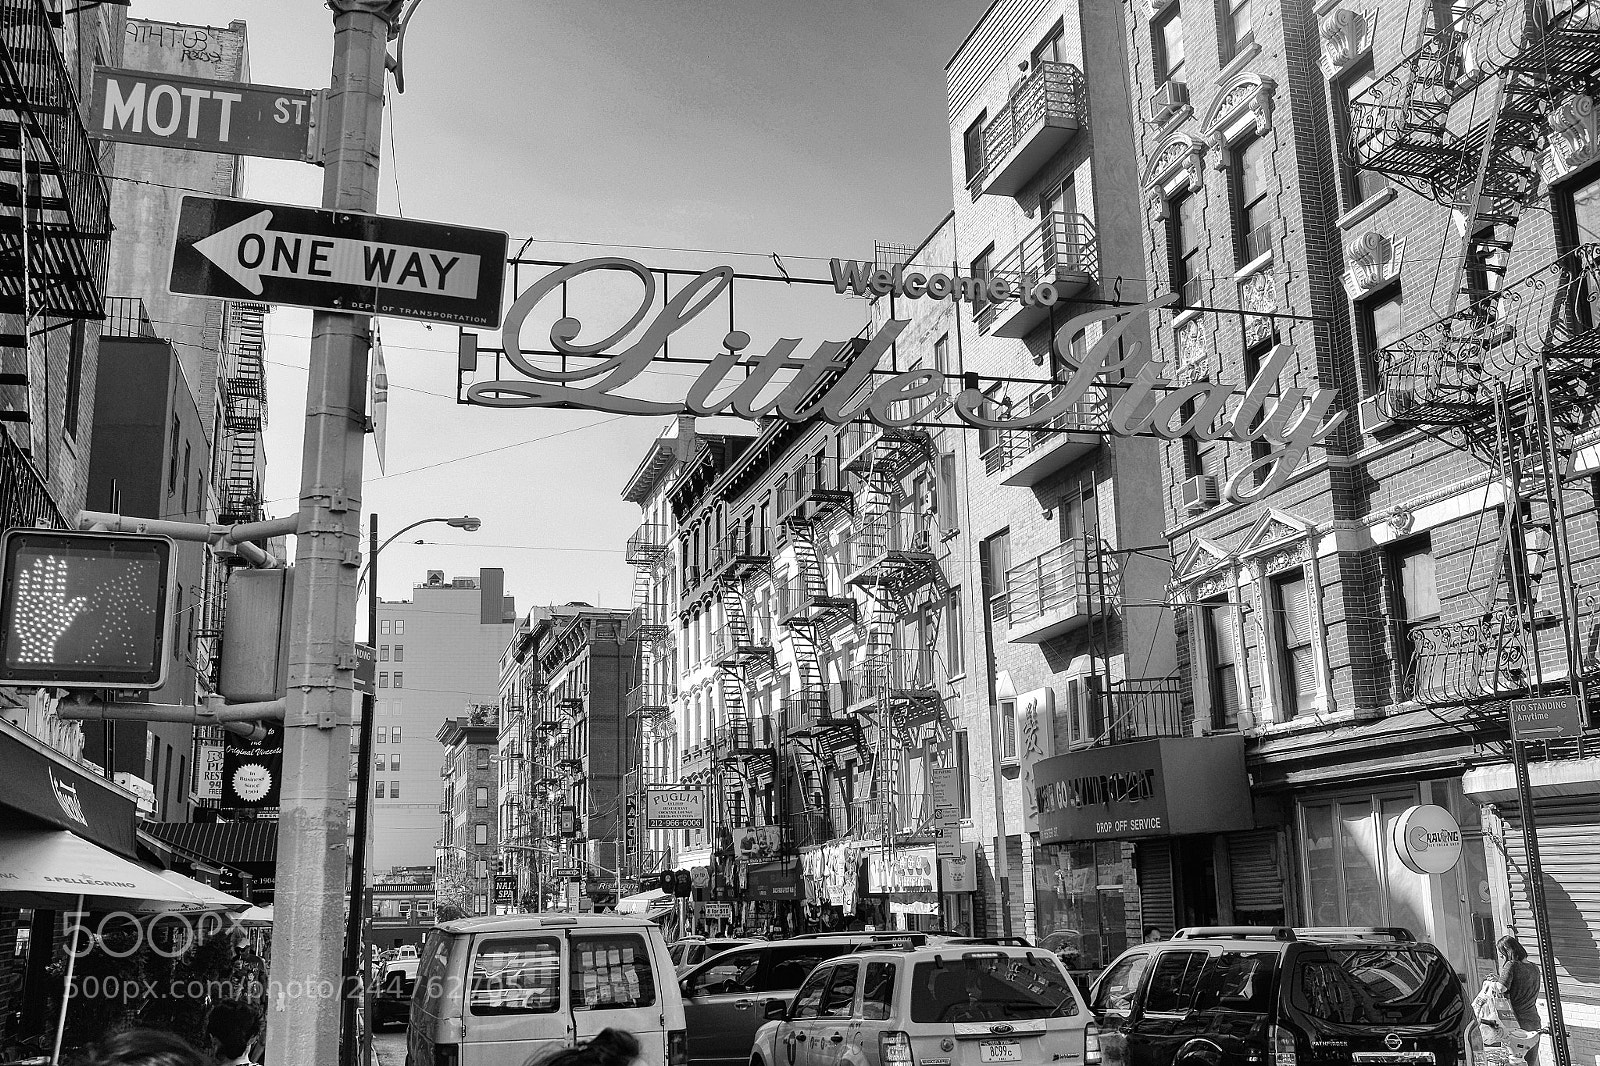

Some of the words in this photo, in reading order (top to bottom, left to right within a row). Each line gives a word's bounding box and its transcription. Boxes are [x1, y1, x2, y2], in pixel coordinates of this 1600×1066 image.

[103, 78, 242, 142] MOTT
[273, 97, 308, 125] ST
[237, 233, 335, 277] ONE
[363, 245, 460, 290] WAY
[830, 257, 1011, 305] Welcome
[1019, 275, 1060, 308] to
[352, 302, 378, 311] DEPT
[382, 305, 395, 313] OF
[399, 307, 487, 324] TRANSPORTATION
[466, 256, 948, 428] Little
[954, 292, 1348, 504] Italy
[1515, 704, 1527, 712] NO
[1528, 701, 1567, 711] STANDING
[1517, 712, 1549, 722] Anytime
[653, 793, 698, 806] PUGLIA
[1096, 822, 1113, 834] DROP
[1115, 820, 1128, 832] OFF
[1130, 817, 1161, 831] SERVICE
[43, 876, 137, 889] S.PELLEGRINO
